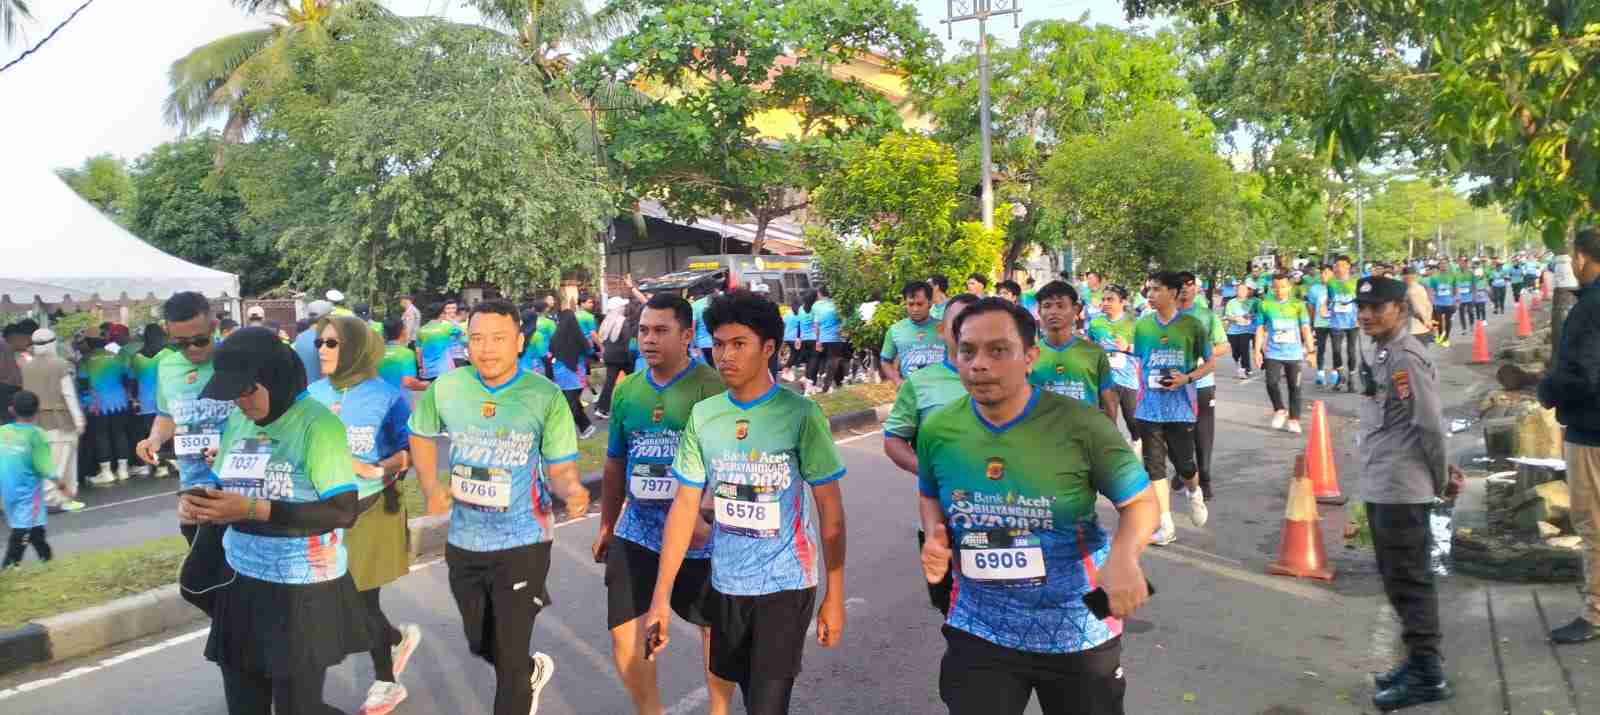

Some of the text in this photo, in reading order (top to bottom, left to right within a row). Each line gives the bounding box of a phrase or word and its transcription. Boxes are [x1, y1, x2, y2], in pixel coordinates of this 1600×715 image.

[760, 451, 790, 464] Aceh
[461, 480, 497, 497] 6766
[641, 479, 672, 492] 7977
[974, 491, 1051, 508] Bank Aceh
[726, 503, 766, 521] 6578
[975, 552, 1028, 570] 6906
